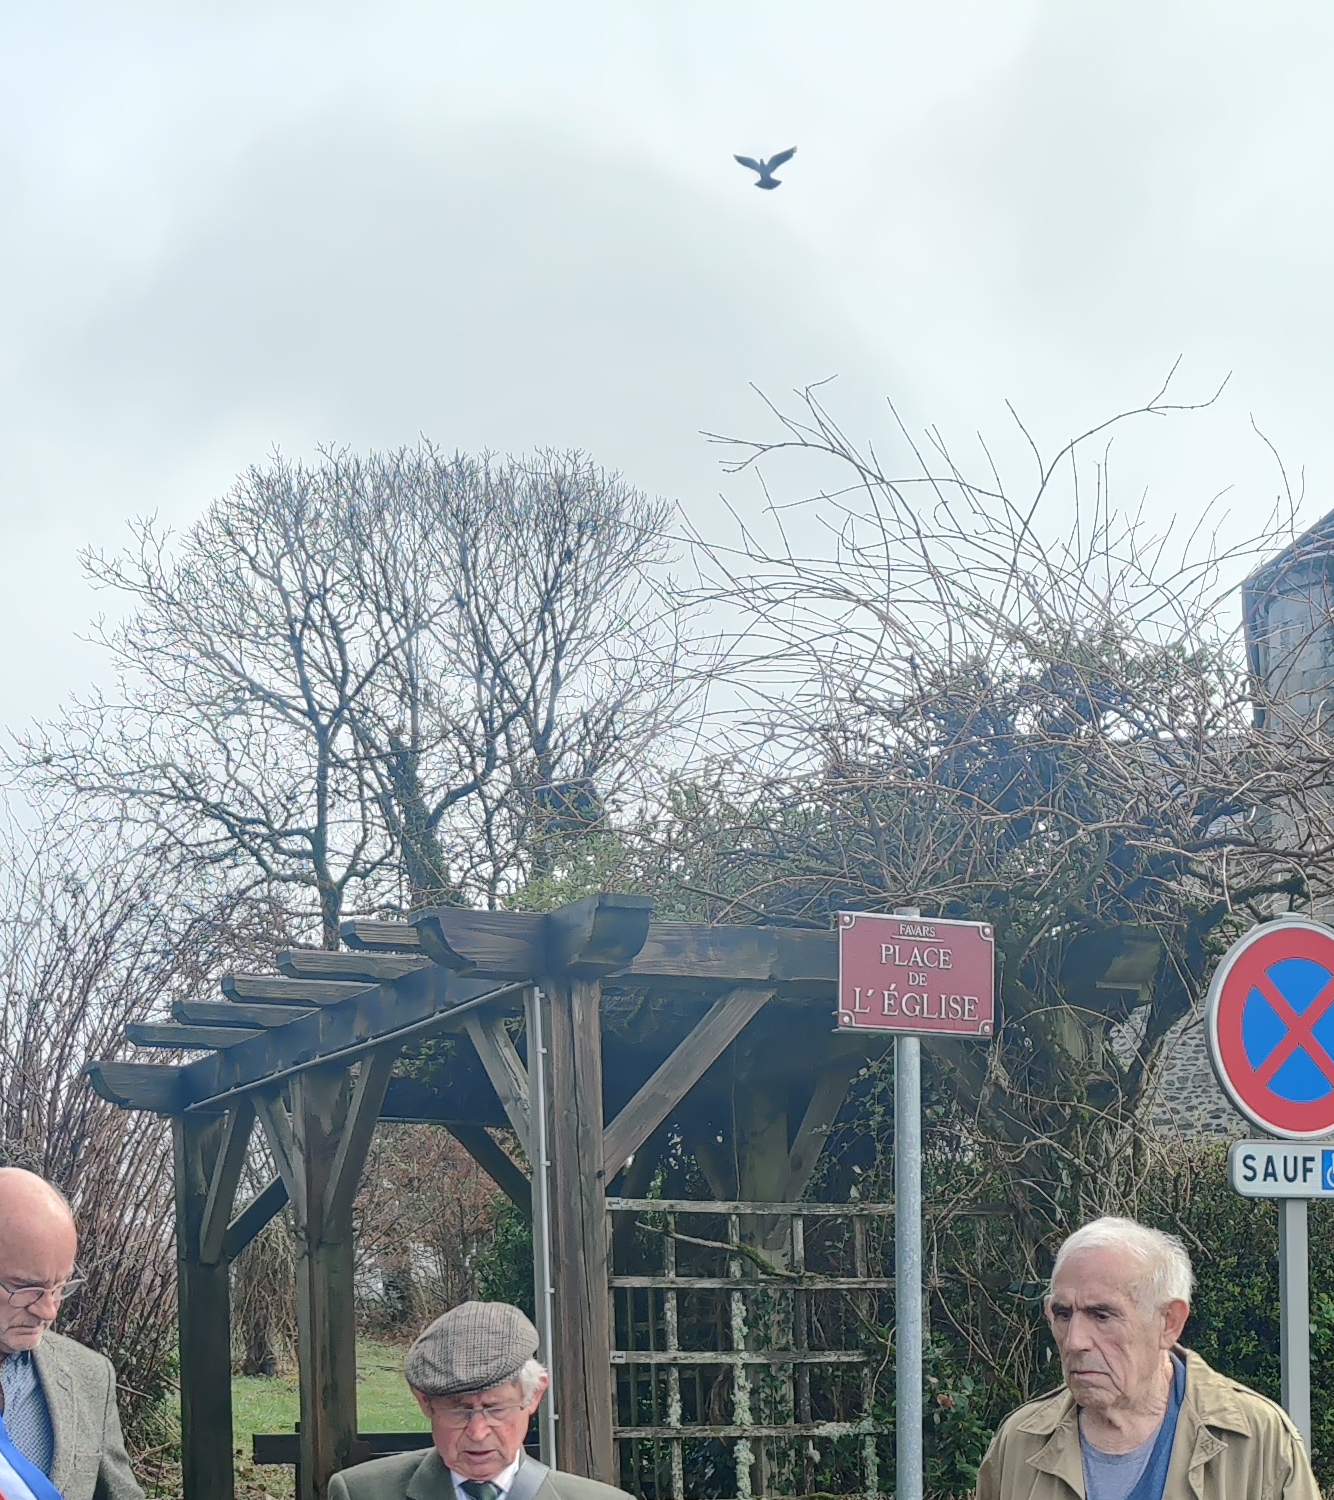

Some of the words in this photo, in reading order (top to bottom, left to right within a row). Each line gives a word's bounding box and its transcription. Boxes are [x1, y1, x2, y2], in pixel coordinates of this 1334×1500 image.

[899, 923, 936, 937] FAVARS
[880, 943, 953, 969] PLACE
[908, 972, 928, 986] DE
[1242, 1153, 1316, 1183] SAUF
